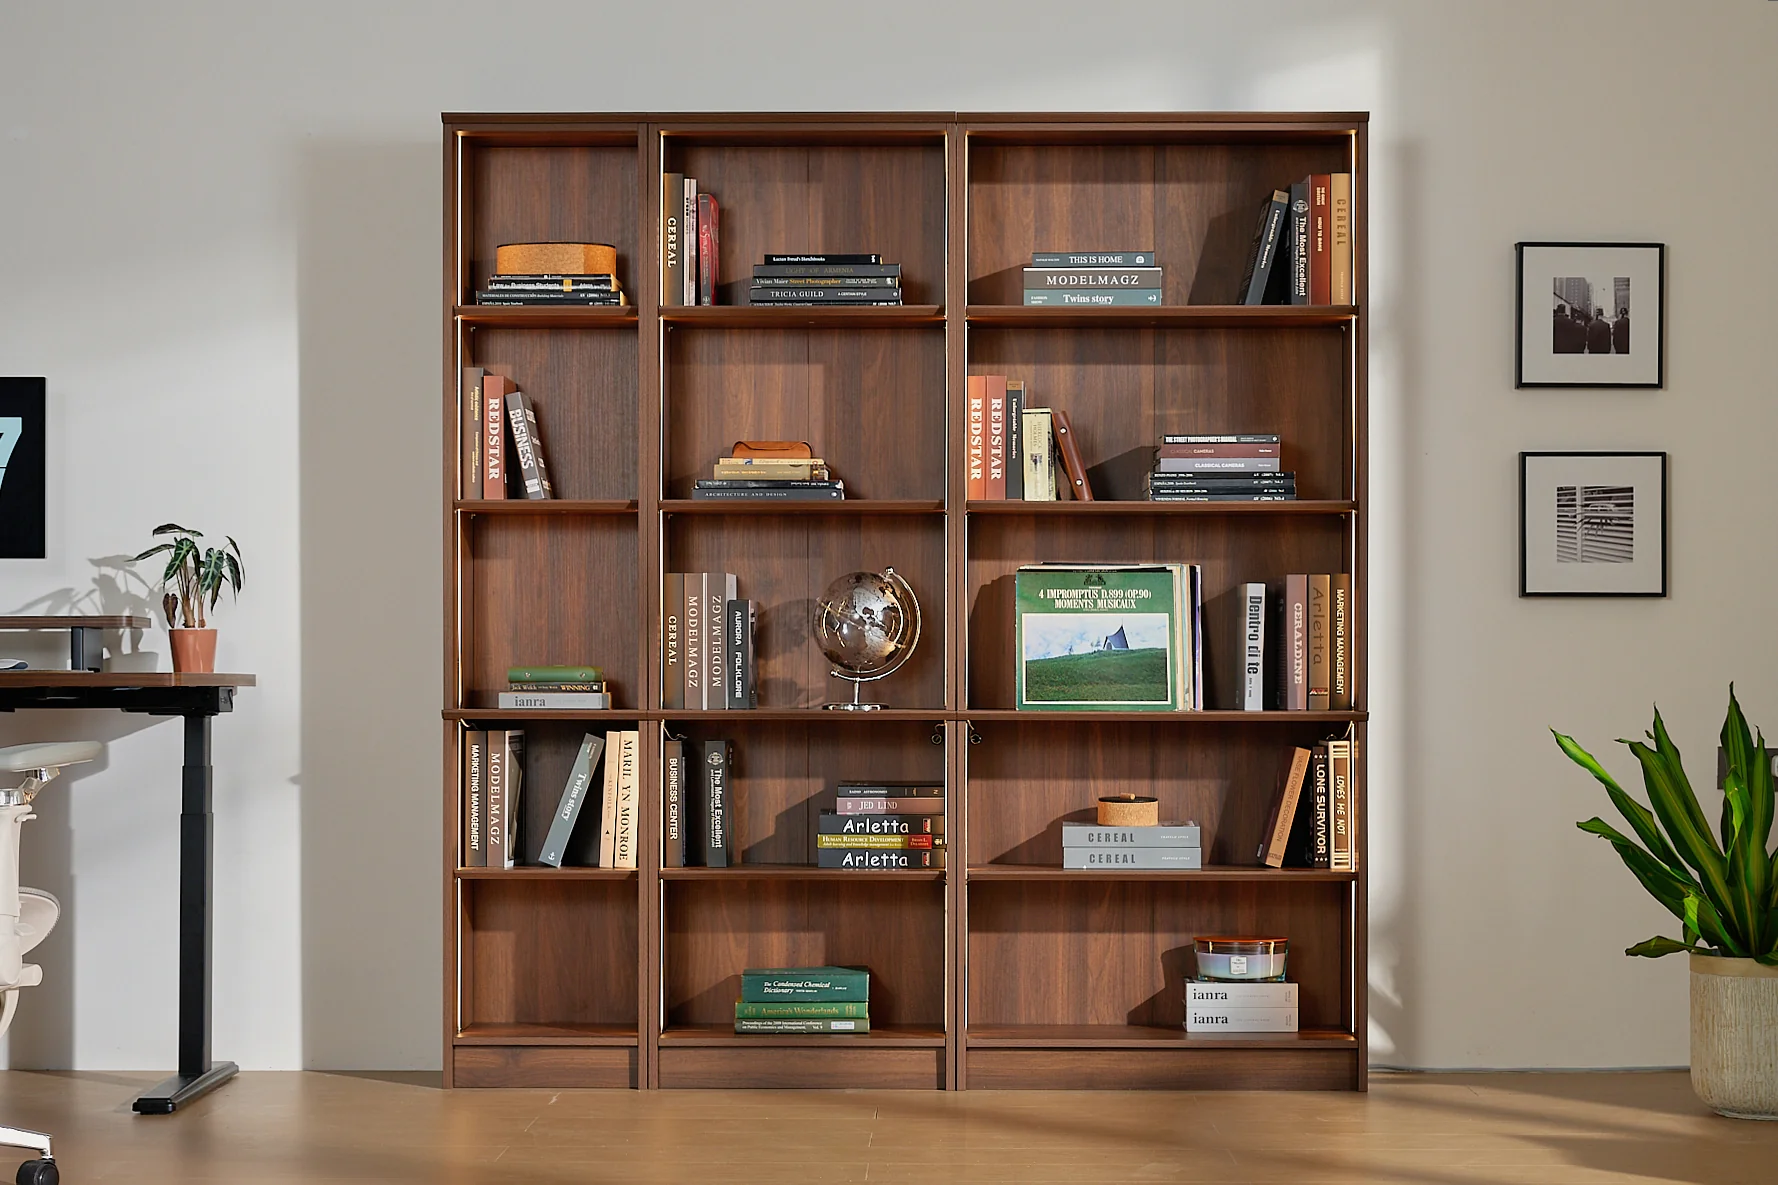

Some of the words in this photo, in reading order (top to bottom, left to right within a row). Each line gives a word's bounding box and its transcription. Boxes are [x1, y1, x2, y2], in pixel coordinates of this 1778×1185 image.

[1299, 216, 1307, 233] The
[1337, 198, 1347, 246] CEREAL
[667, 217, 677, 268] CEREAL
[1299, 234, 1307, 256] Most
[1068, 255, 1088, 264] THIS
[1089, 255, 1098, 264] IS
[1098, 255, 1123, 264] HOME
[805, 278, 841, 286] Photographer
[1046, 275, 1139, 285] MODELMAGZ
[1299, 257, 1307, 297] Excellent
[1063, 294, 1091, 303] Twins
[1091, 294, 1114, 305] story
[489, 398, 500, 480] REDSTAR
[509, 408, 534, 470] BUSINESS
[970, 398, 982, 481] REDSTAR
[990, 398, 1002, 481] REDSTAR
[1038, 589, 1044, 599] 4
[1046, 589, 1099, 599] IMPROMPTUS
[1101, 589, 1124, 599] D.899
[1124, 589, 1152, 600] (OP.90)
[1054, 599, 1094, 609] MOMENTS
[1096, 599, 1137, 609] MUSICAUX
[1248, 595, 1262, 641] Dentro
[1336, 589, 1344, 636] MARKETING
[1313, 587, 1325, 665] Arletta
[668, 615, 677, 666] CEREAL
[688, 595, 698, 688] MODELMAGZ
[712, 595, 722, 687] MODELMAGZ
[1248, 645, 1261, 658] di
[1247, 662, 1260, 675] te
[1336, 637, 1344, 695] MANAGEMENT
[514, 696, 546, 707] ianra
[471, 744, 480, 792] MARKETING
[714, 768, 722, 784] The
[1295, 755, 1304, 772] VASE
[570, 773, 587, 798] Twins
[669, 758, 678, 802] BUSINESS
[1287, 772, 1300, 800] FLOWER
[1317, 764, 1326, 794] LONE
[1336, 775, 1346, 800] LOVES
[491, 753, 501, 845] MODELMAGZ
[714, 786, 722, 807] Most
[858, 801, 874, 810] JED
[877, 801, 898, 810] LIND
[471, 793, 480, 851] MANAGEMENT
[561, 799, 576, 822] story
[669, 803, 678, 840] CENTER
[1276, 800, 1292, 842] DECORATION
[619, 807, 630, 861] MONROE
[714, 809, 722, 848] Excellent
[843, 818, 909, 834] Arletta
[1317, 795, 1326, 854] SURVIVOR
[1336, 818, 1346, 836] NOT
[1088, 832, 1135, 843] CEREAL
[842, 852, 909, 867] Arletta
[1089, 853, 1136, 864] CEREAL
[1193, 988, 1228, 1000] ianra
[761, 1006, 793, 1015] America's
[793, 1006, 839, 1015] Wonderlands
[1193, 1012, 1229, 1024] ianra
